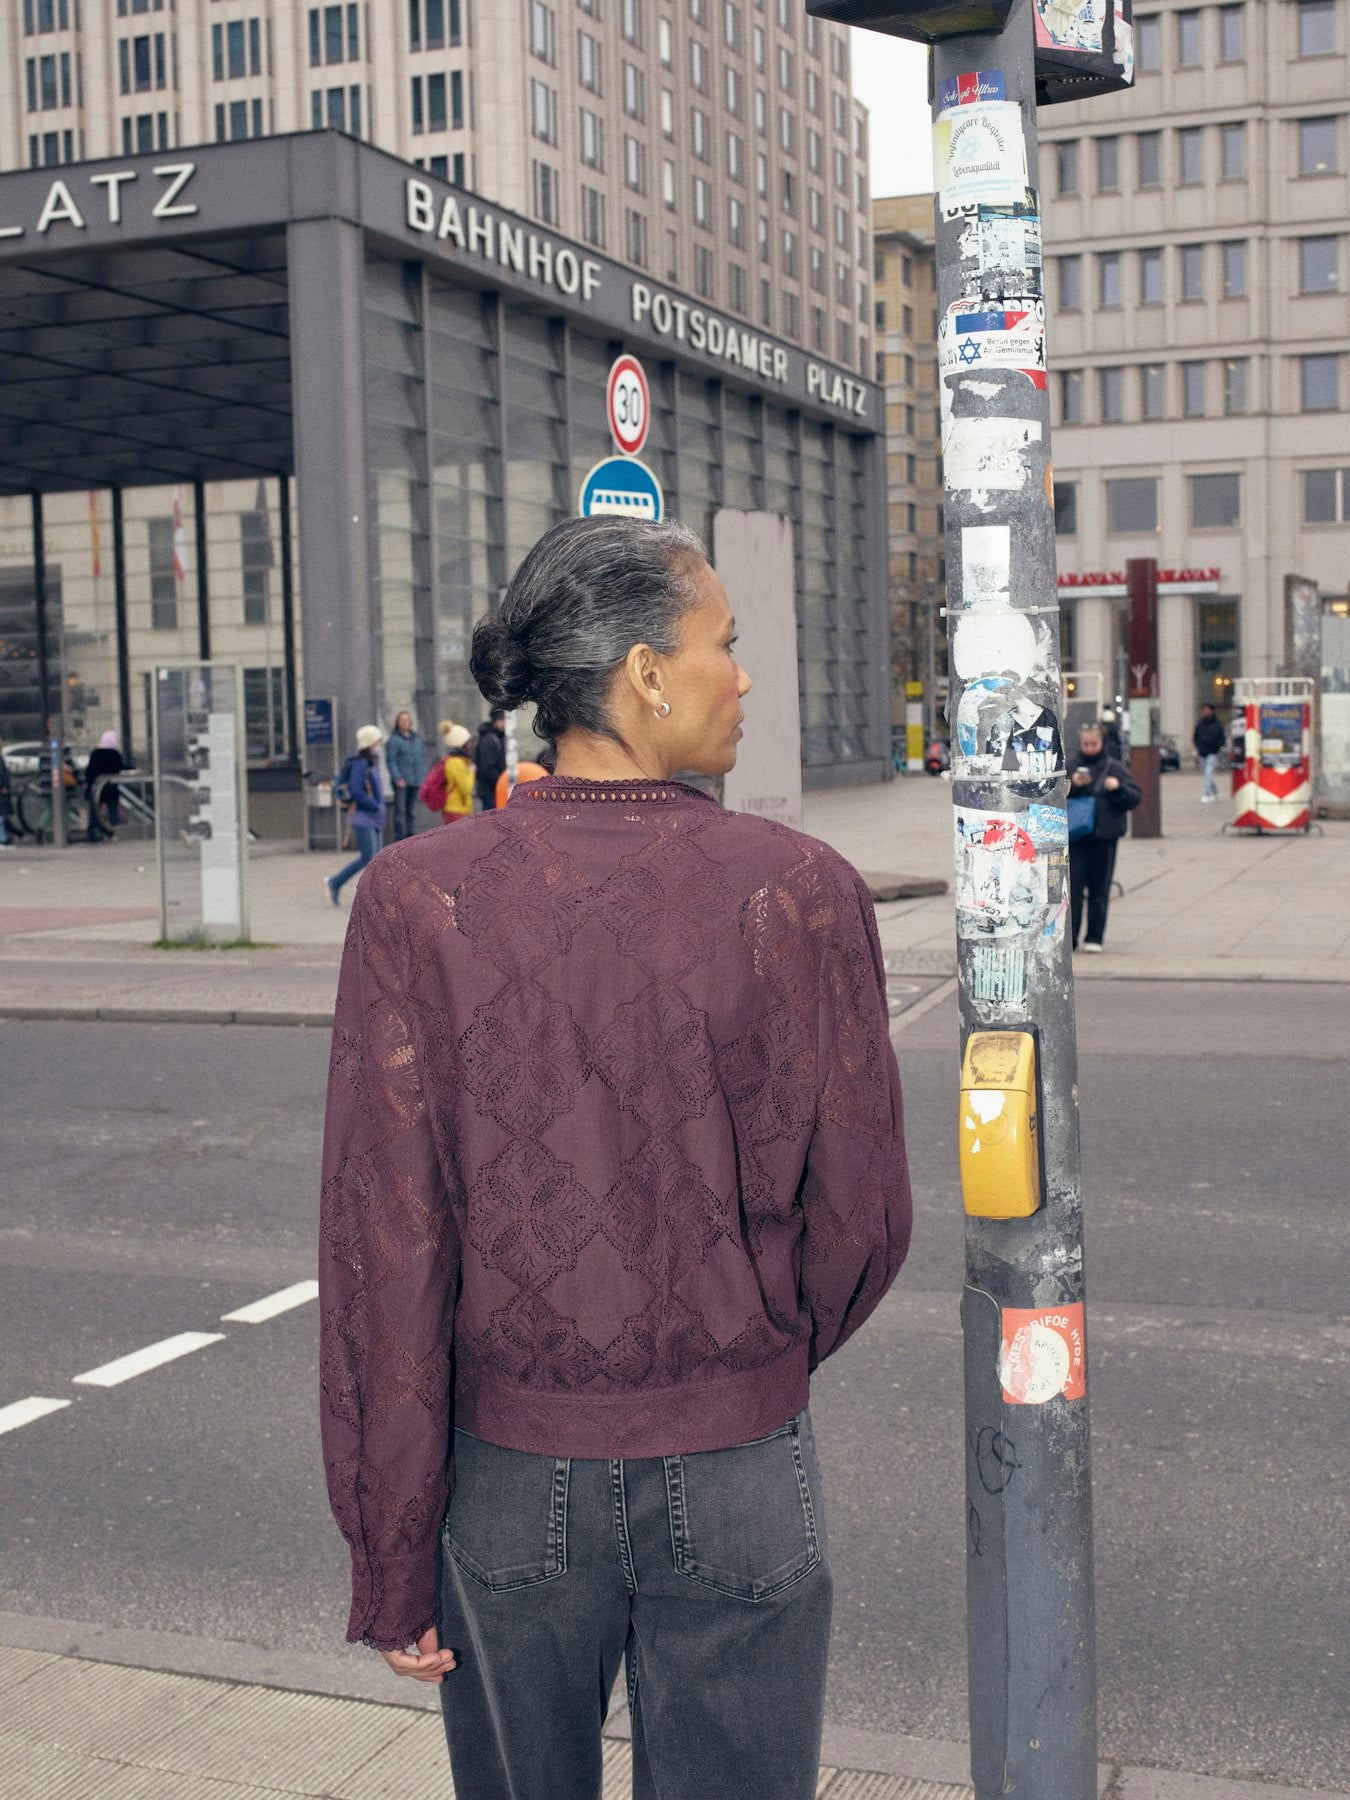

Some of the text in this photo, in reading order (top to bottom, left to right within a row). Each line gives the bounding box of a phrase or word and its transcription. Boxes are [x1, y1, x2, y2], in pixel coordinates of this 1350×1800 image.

[405, 178, 868, 417] BAHNHOF POTSDAMER PLATZ
[1010, 338, 1030, 346] gegen
[617, 383, 639, 428] 30
[1070, 1328, 1082, 1367] HYDE
